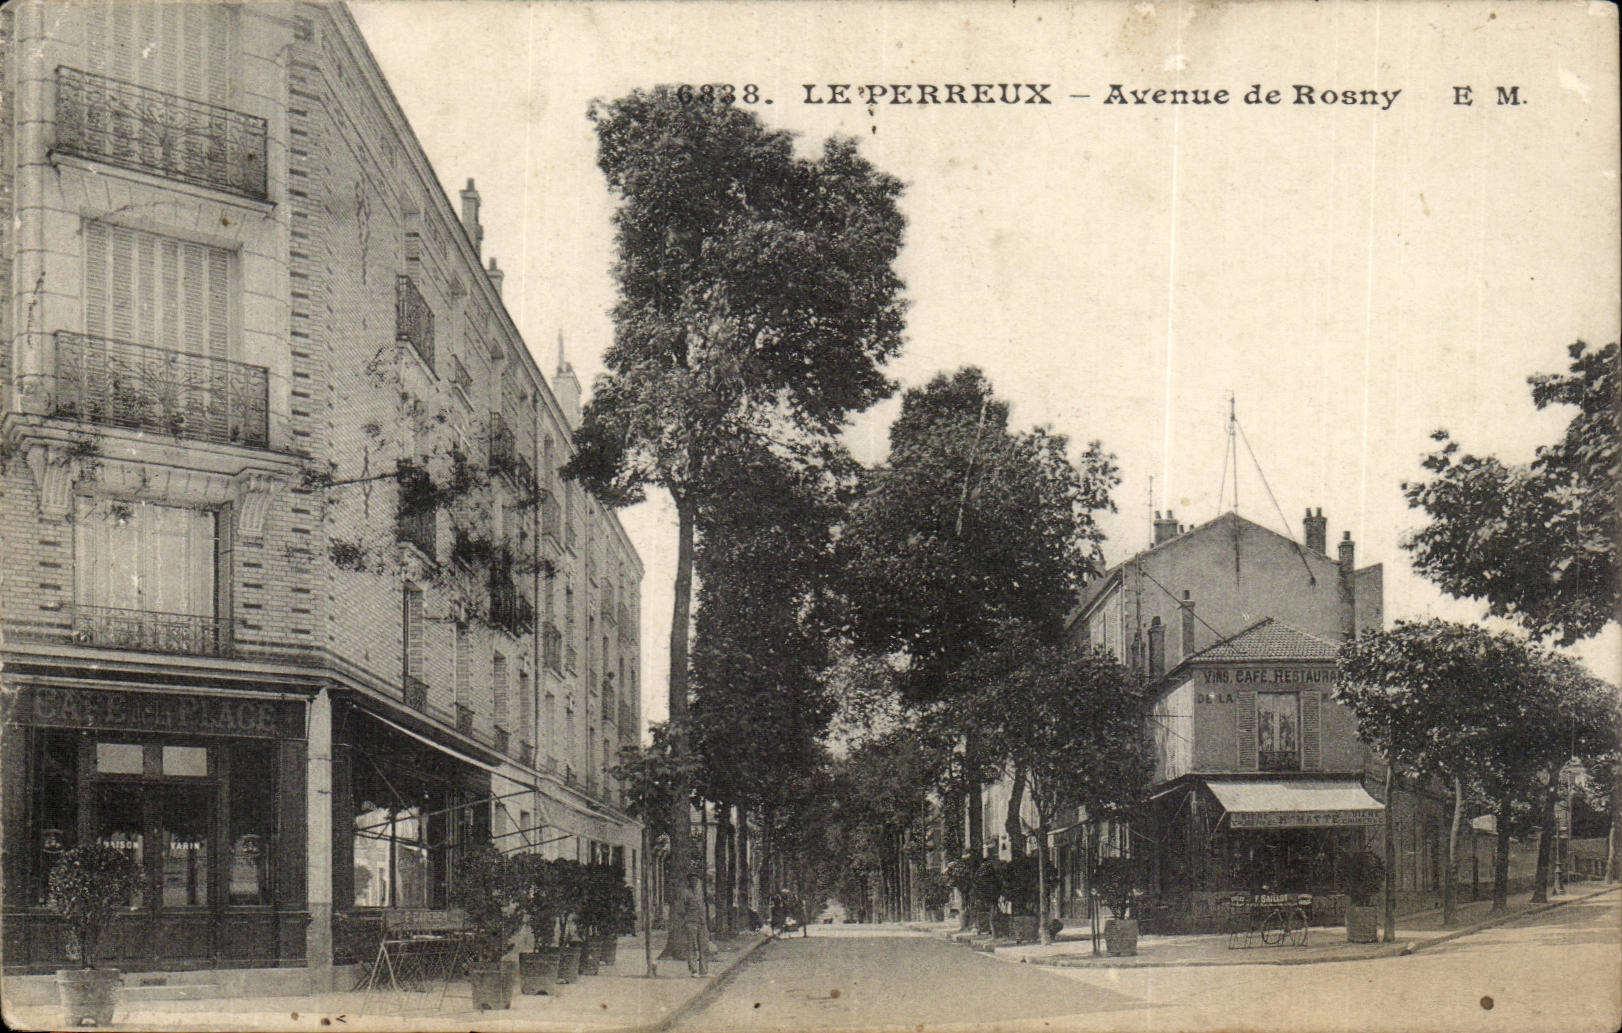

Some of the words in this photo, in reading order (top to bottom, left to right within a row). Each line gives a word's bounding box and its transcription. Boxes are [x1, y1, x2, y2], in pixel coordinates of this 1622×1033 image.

[1274, 669, 1344, 684] RESTAURAN
[1197, 693, 1213, 704] DE
[1218, 693, 1234, 704] LA
[177, 697, 278, 730] PLACE
